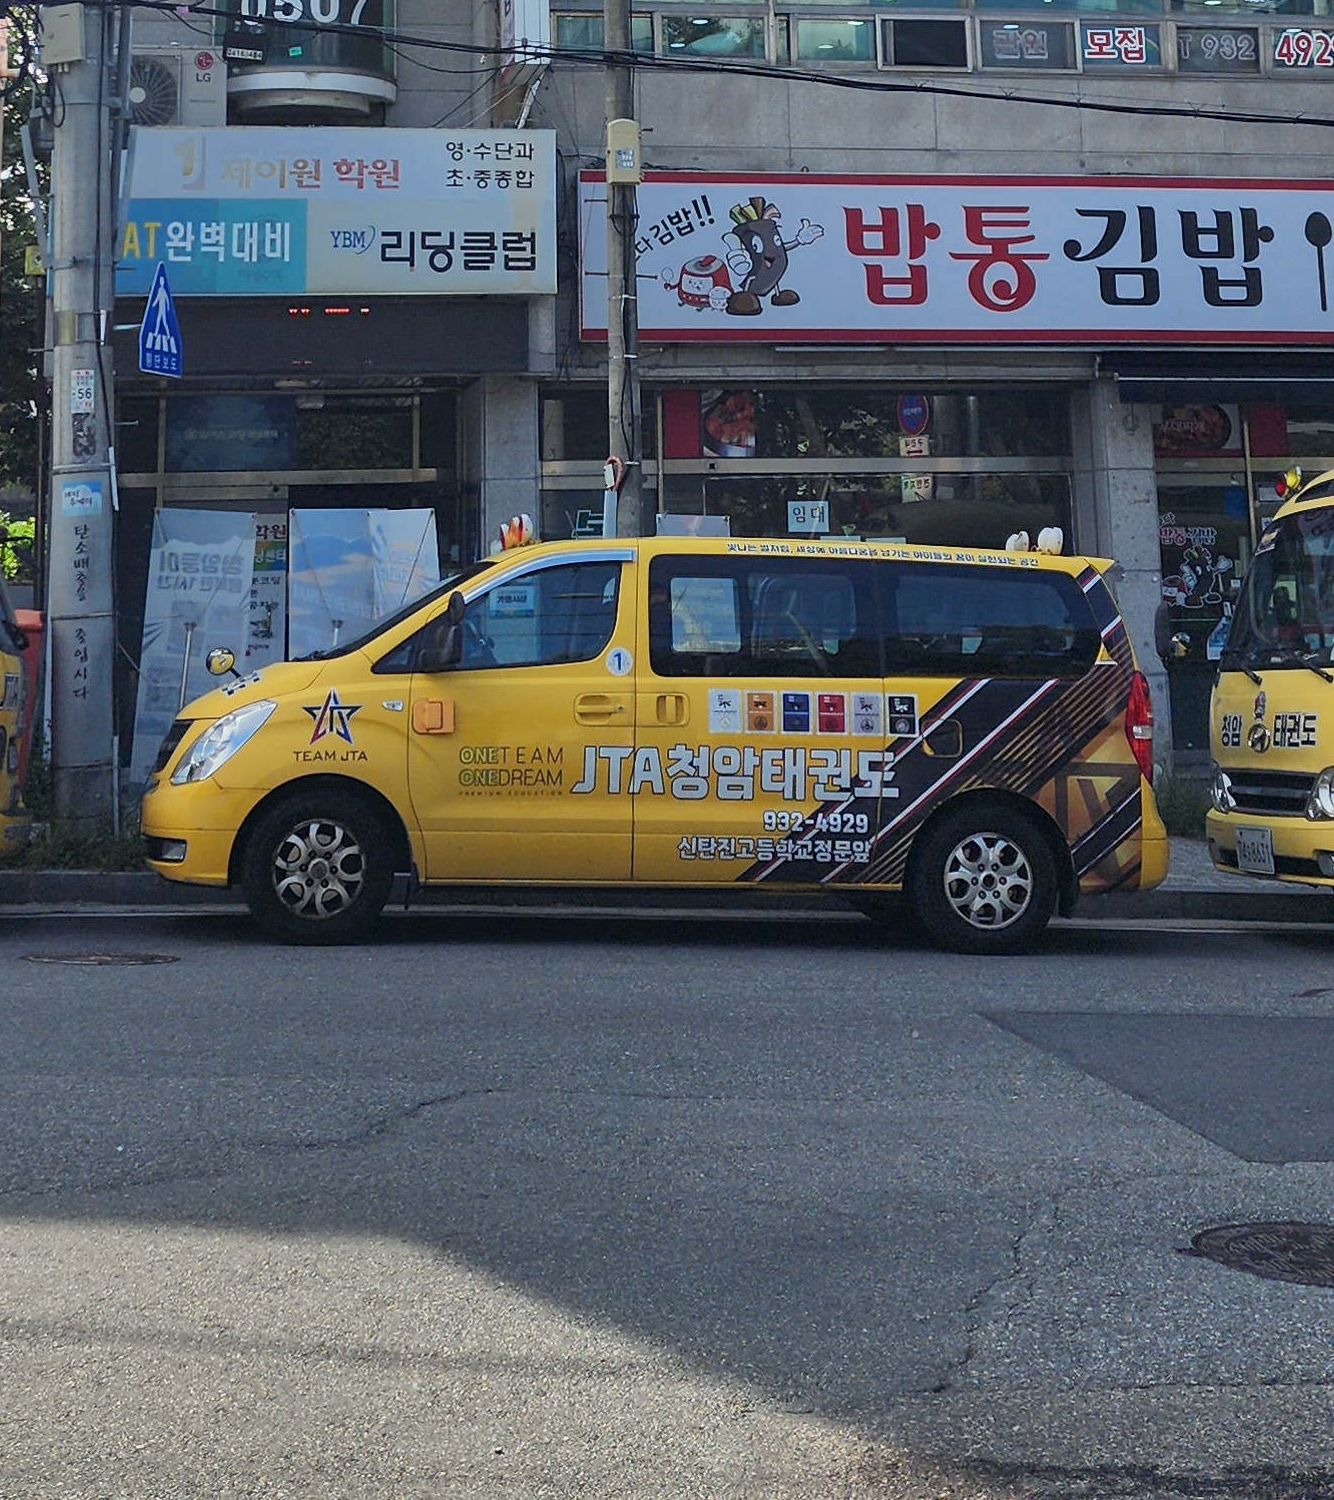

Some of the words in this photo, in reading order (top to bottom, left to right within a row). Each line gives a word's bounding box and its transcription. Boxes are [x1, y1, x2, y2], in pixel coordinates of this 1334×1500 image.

[1084, 26, 1147, 64] 모집
[1199, 33, 1257, 61] 932
[196, 73, 211, 83] LG
[220, 158, 322, 190] 제이원
[333, 158, 401, 190] 학원
[165, 221, 291, 263] 완벽대비
[330, 230, 367, 250] YBM
[380, 228, 537, 273] 리딩클럽
[792, 503, 828, 526] 임대
[1221, 713, 1243, 748] 청암
[1272, 712, 1319, 748] 태권도
[293, 750, 337, 762] TEAM
[340, 750, 368, 762] JTA
[762, 810, 869, 835] 932-4929
